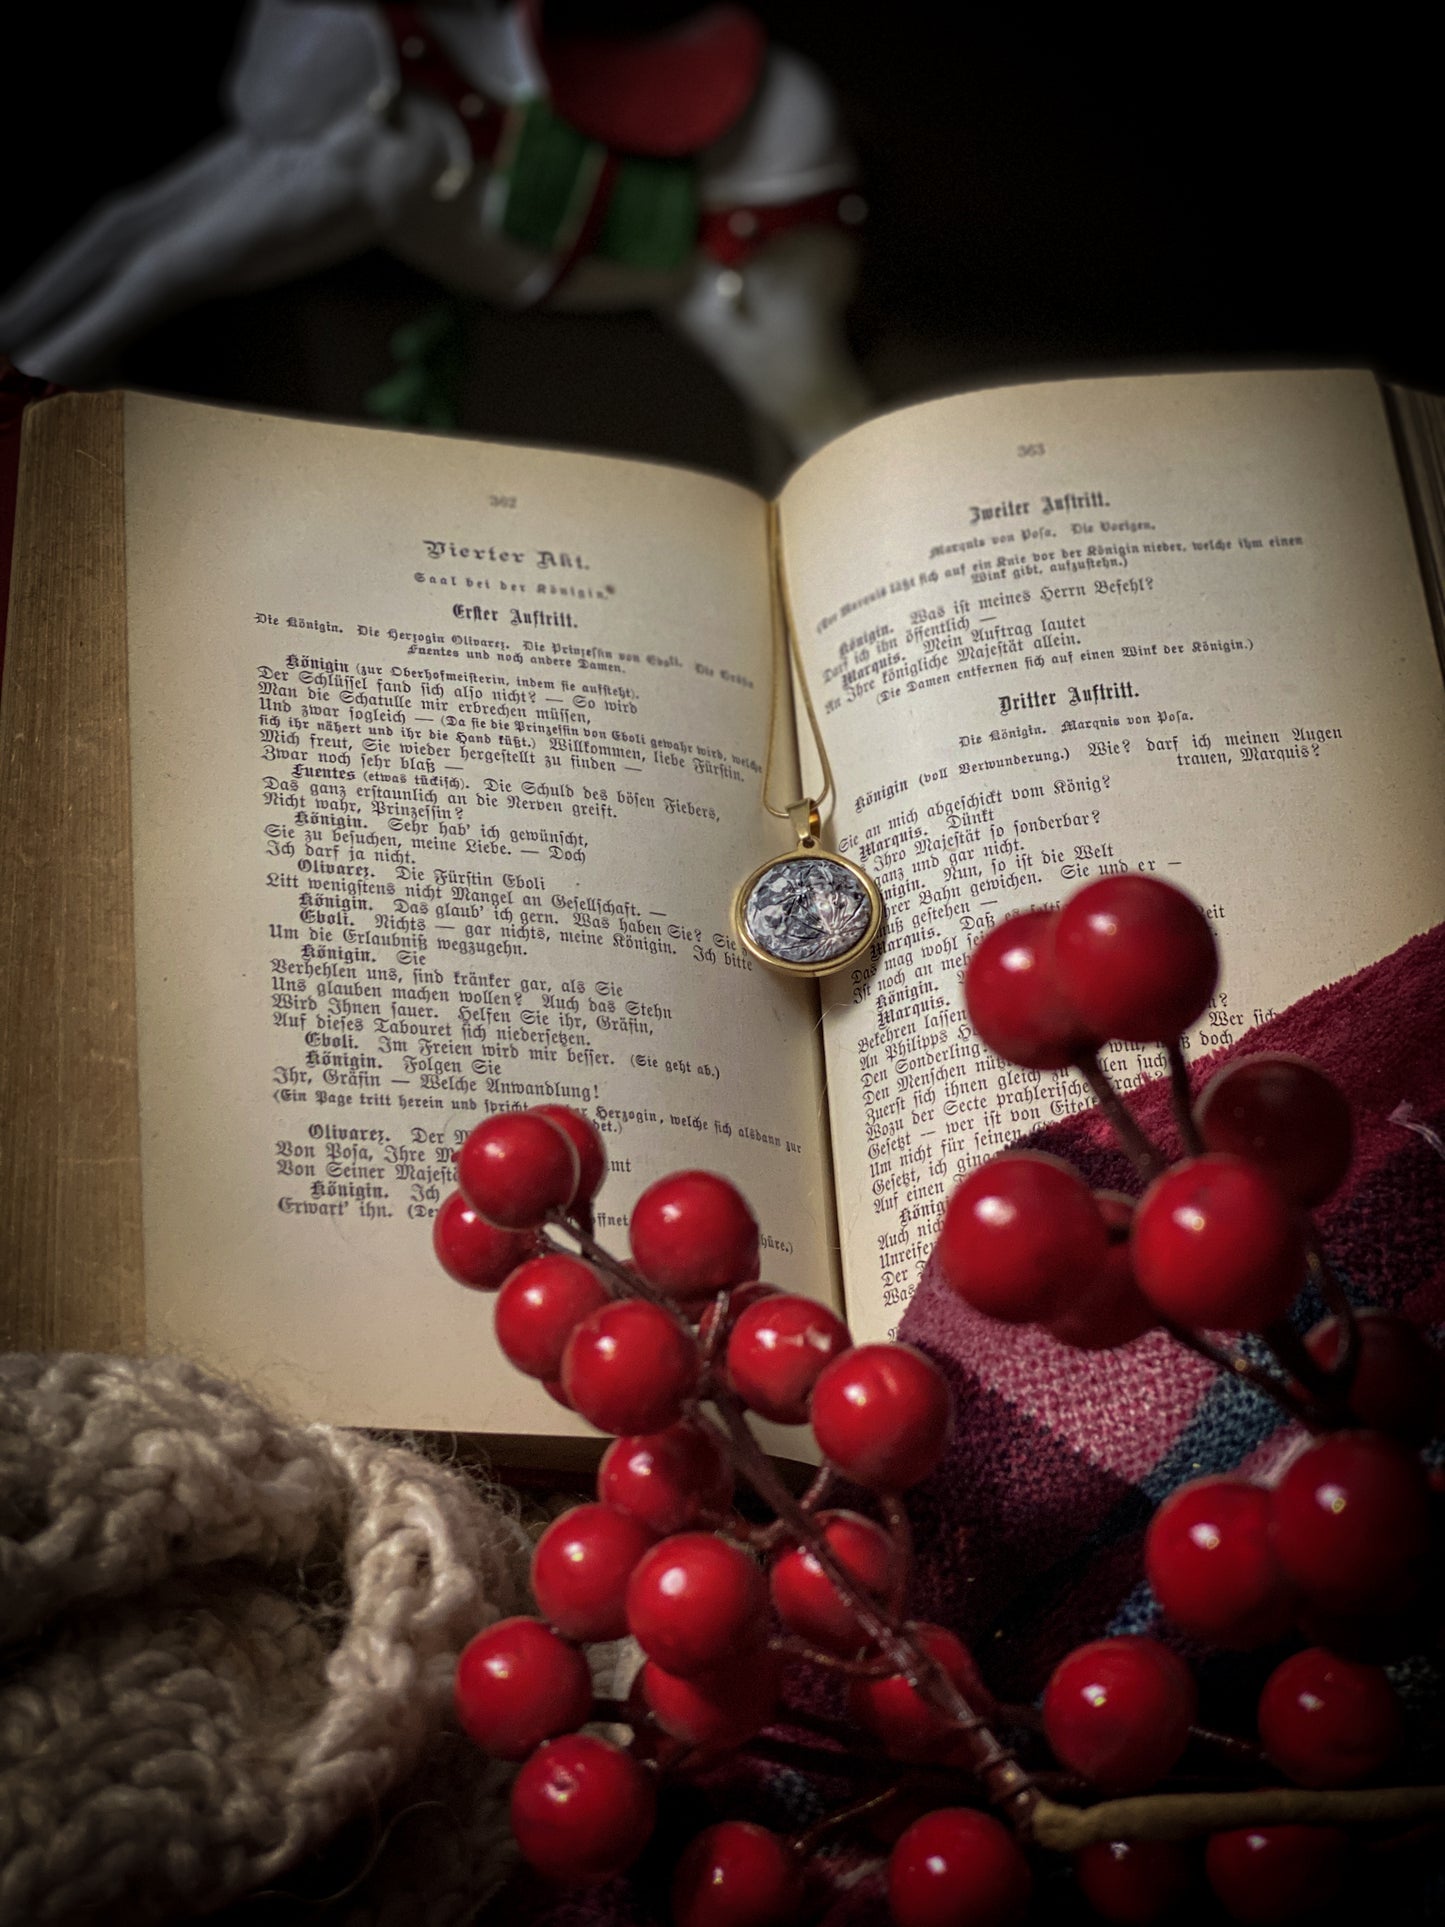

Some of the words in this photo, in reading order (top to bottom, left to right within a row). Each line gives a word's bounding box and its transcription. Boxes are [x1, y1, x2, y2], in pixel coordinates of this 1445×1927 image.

[423, 540, 524, 563] Vierter
[979, 590, 1031, 610] meines
[1040, 584, 1085, 602] Herrn
[1095, 577, 1153, 595] Befehl?
[286, 617, 343, 633] Königin.
[388, 629, 444, 645] Herzogin
[510, 609, 577, 629] Auftritt.
[906, 617, 970, 643] öffentlich
[923, 633, 962, 654] Mein
[971, 621, 1032, 642] Auftrag
[1042, 616, 1085, 632] lautet
[285, 655, 349, 673] Königin
[530, 655, 571, 667] andere
[577, 659, 626, 673] Damen.
[882, 655, 948, 685] königliche
[1033, 634, 1081, 649] allein.
[957, 660, 1018, 680] entfernen
[1192, 639, 1253, 653] Königin.)
[258, 682, 297, 698] Man
[339, 690, 412, 709] Schatulle
[458, 702, 527, 718] erbrechen
[492, 690, 536, 704] nicht?
[605, 699, 637, 714] wird
[998, 690, 1056, 715] Dritter
[1068, 682, 1139, 706] Auftritt.
[259, 697, 291, 713] Und
[301, 703, 339, 718] zwar
[650, 737, 692, 753] gewahr
[989, 725, 1046, 743] Königin.
[259, 729, 300, 746] Mich
[310, 733, 352, 750] freut,
[400, 743, 450, 757] wieder
[571, 752, 616, 772] finden
[317, 721, 361, 734] nähert
[550, 738, 646, 762] Willkommen,
[654, 750, 685, 768] liebe
[1088, 739, 1131, 757] Wie?
[1225, 731, 1280, 746] meinen
[1292, 727, 1342, 743] Augen
[1177, 751, 1232, 767] trauen,
[1242, 743, 1320, 763] Marquis?
[261, 745, 308, 761] Zwar
[401, 757, 436, 773] blaß
[262, 777, 299, 791] Das
[310, 782, 346, 800] ganz
[507, 797, 562, 813] Nerven
[572, 803, 617, 819] greift.
[263, 792, 306, 809] Nicht
[315, 799, 361, 814] wahr,
[521, 781, 574, 798] Schuld
[665, 798, 720, 822] Fiebers,
[889, 809, 918, 829] mich
[1053, 774, 1111, 796] König?
[295, 811, 367, 829] Königin.
[388, 818, 428, 834] Sehr
[947, 809, 994, 829] Dünkt
[305, 844, 340, 859] darf
[375, 849, 416, 864] nicht.
[412, 838, 456, 851] meine
[466, 839, 512, 855] Liebe.
[549, 846, 586, 864] Doch
[874, 850, 906, 872] Ihro
[984, 838, 1024, 857] nicht.
[297, 859, 375, 880] Olivarez.
[502, 873, 545, 890] Eboli
[943, 866, 982, 882] Nun,
[1074, 844, 1114, 860] Welt
[266, 873, 299, 888] Litt
[406, 885, 442, 899] nicht
[452, 887, 514, 906] Mangel
[919, 883, 961, 905] Bahn
[971, 873, 1042, 897] gewichen.
[299, 892, 373, 911] Königin.
[520, 910, 558, 926] gern.
[620, 917, 661, 937] haben
[668, 925, 702, 942] Sie?
[269, 924, 299, 940] Um
[437, 937, 528, 958] wegzugehn.
[300, 909, 354, 926] Eboli.
[375, 915, 426, 931] Nichts
[560, 930, 603, 946] meine
[613, 934, 676, 955] Königin.
[885, 951, 913, 971] mag
[921, 935, 958, 958] wohl
[270, 959, 356, 979] Verhehlen
[454, 972, 510, 988] kränker
[272, 977, 306, 991] Uns
[317, 983, 382, 998] glauben
[392, 987, 449, 1002] machen
[542, 995, 579, 1012] Auch
[625, 1001, 672, 1020] Stehn
[272, 994, 317, 1010] Wird
[328, 998, 380, 1016] Ihnen
[458, 1007, 510, 1023] Helfen
[876, 981, 938, 1012] Königin.
[374, 1018, 451, 1037] Tabouret
[878, 996, 950, 1030] Marquis.
[1209, 1012, 1243, 1027] Wer
[418, 1039, 472, 1056] Freien
[857, 1022, 916, 1054] Bekehren
[886, 1029, 947, 1060] Philipps
[1201, 1029, 1233, 1045] doch
[404, 1056, 461, 1074] Folgen
[861, 1070, 888, 1088] Den
[895, 1043, 988, 1074] Sonderling.
[421, 1075, 477, 1093] Welche
[486, 1078, 599, 1101] Anwandlung!
[945, 1079, 987, 1098] ihnen
[998, 1069, 1041, 1090] gleich
[315, 1091, 352, 1106] Page
[399, 1093, 443, 1110] herein
[309, 1124, 390, 1144] Olivarez.
[866, 1118, 904, 1142] Wozu
[275, 1141, 315, 1159] Von
[384, 1146, 425, 1163] Ihre
[900, 1145, 932, 1168] nicht
[941, 1138, 965, 1158] für
[326, 1162, 385, 1179] Seiner
[311, 1181, 388, 1200] Königin.
[874, 1194, 899, 1214] Auf
[907, 1182, 944, 1202] einen
[360, 1203, 392, 1222] ihn.
